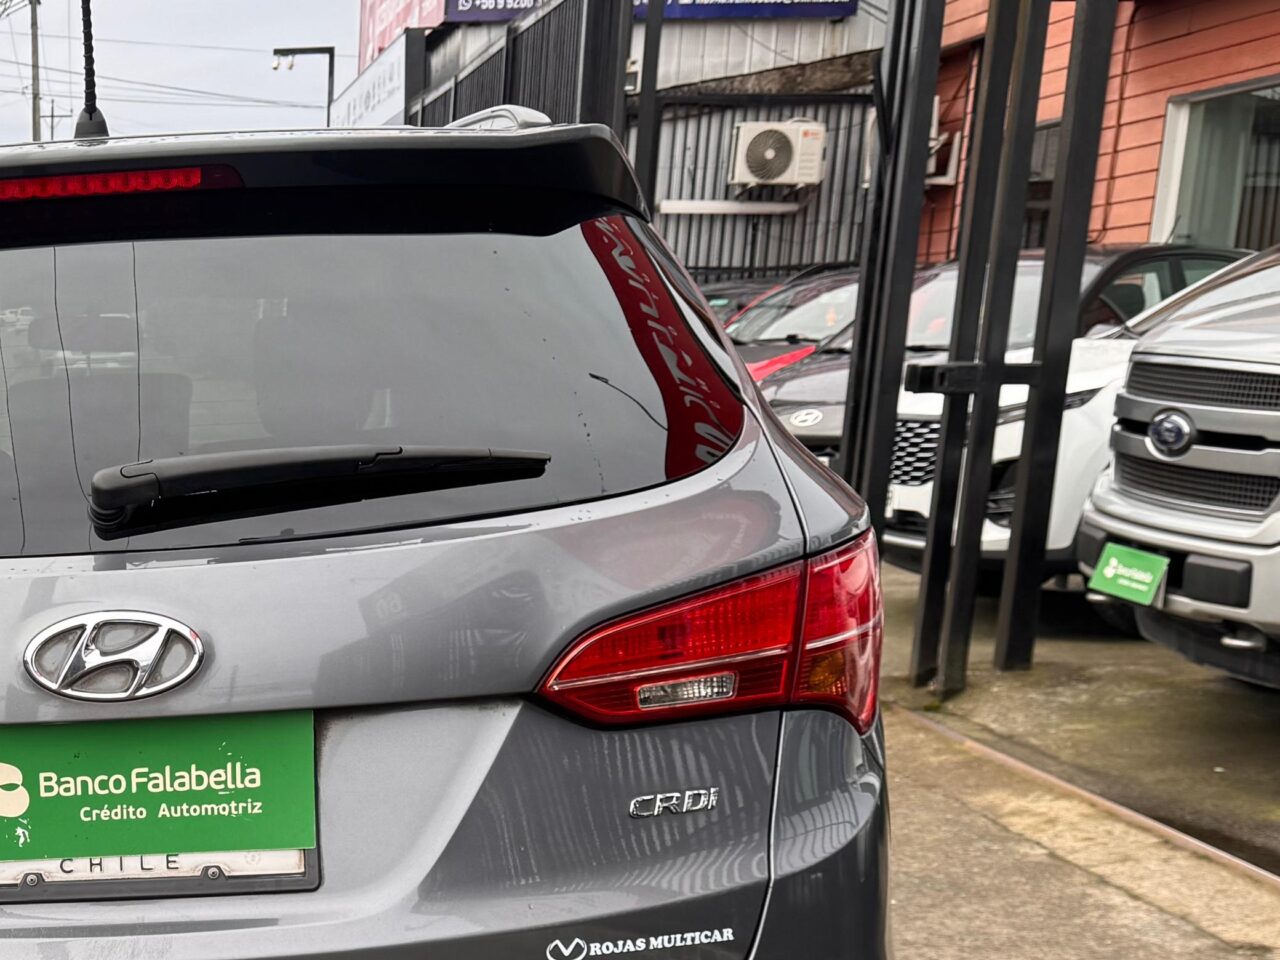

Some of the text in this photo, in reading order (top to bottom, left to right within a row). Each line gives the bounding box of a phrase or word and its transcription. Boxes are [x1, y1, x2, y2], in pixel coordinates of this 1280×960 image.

[80, 798, 263, 822] Crédito Automotriz
[59, 853, 180, 875] CHILE
[589, 927, 735, 956] ROJAS MULTICAR
